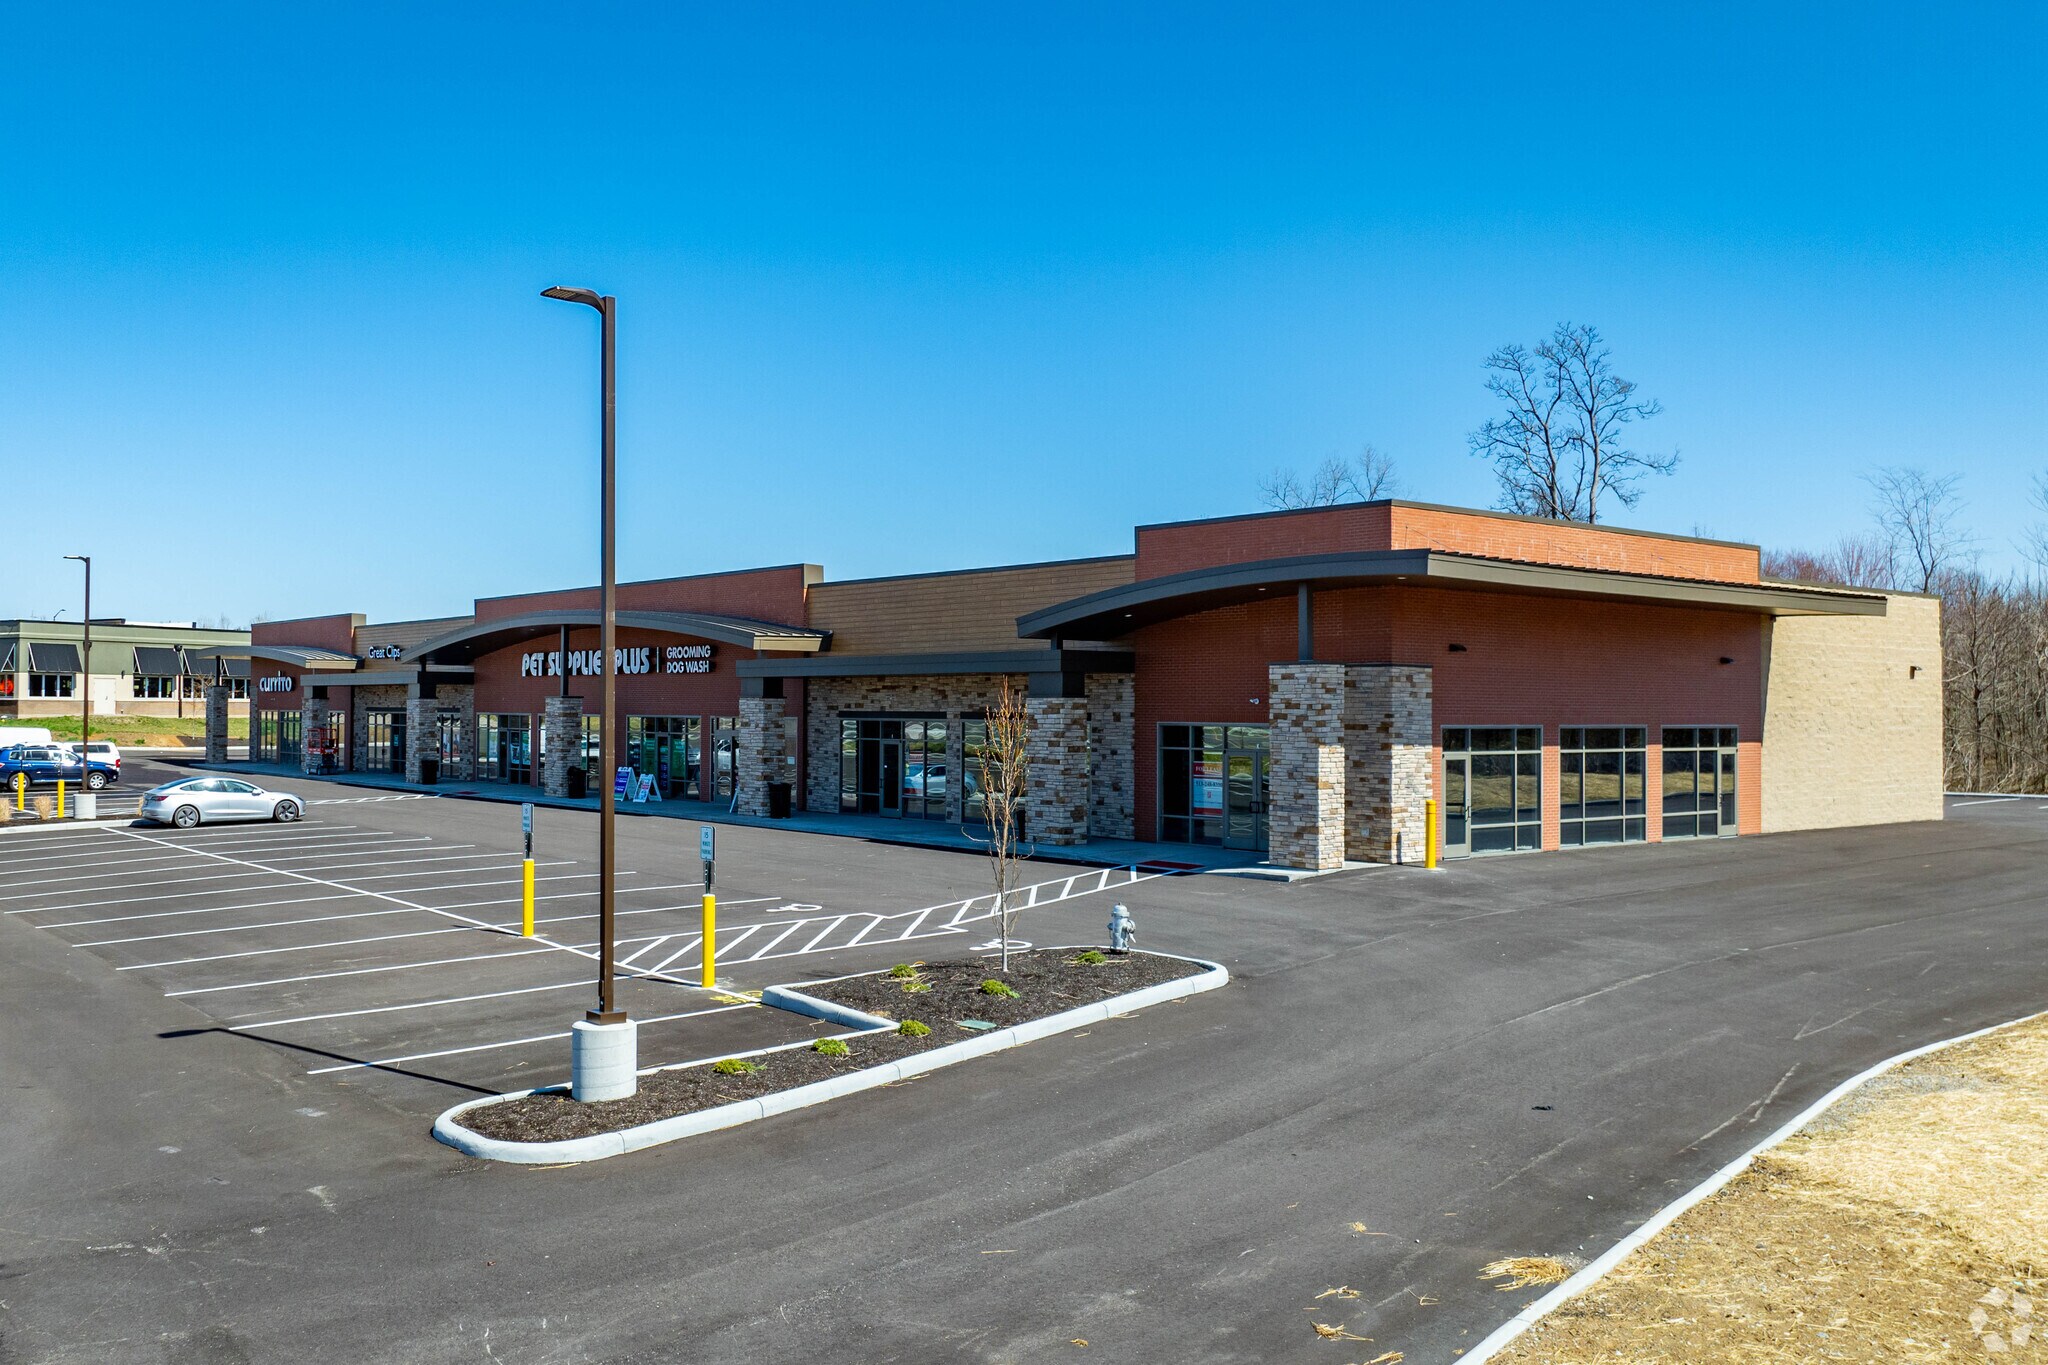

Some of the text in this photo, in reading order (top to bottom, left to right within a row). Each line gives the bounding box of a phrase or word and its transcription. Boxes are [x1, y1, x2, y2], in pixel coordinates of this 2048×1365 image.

[368, 643, 401, 661] Great Clips
[666, 645, 711, 659] GROOMING
[522, 647, 650, 677] PET SUPLIE PLUS
[666, 660, 710, 673] DOG WASH
[259, 670, 292, 692] currito
